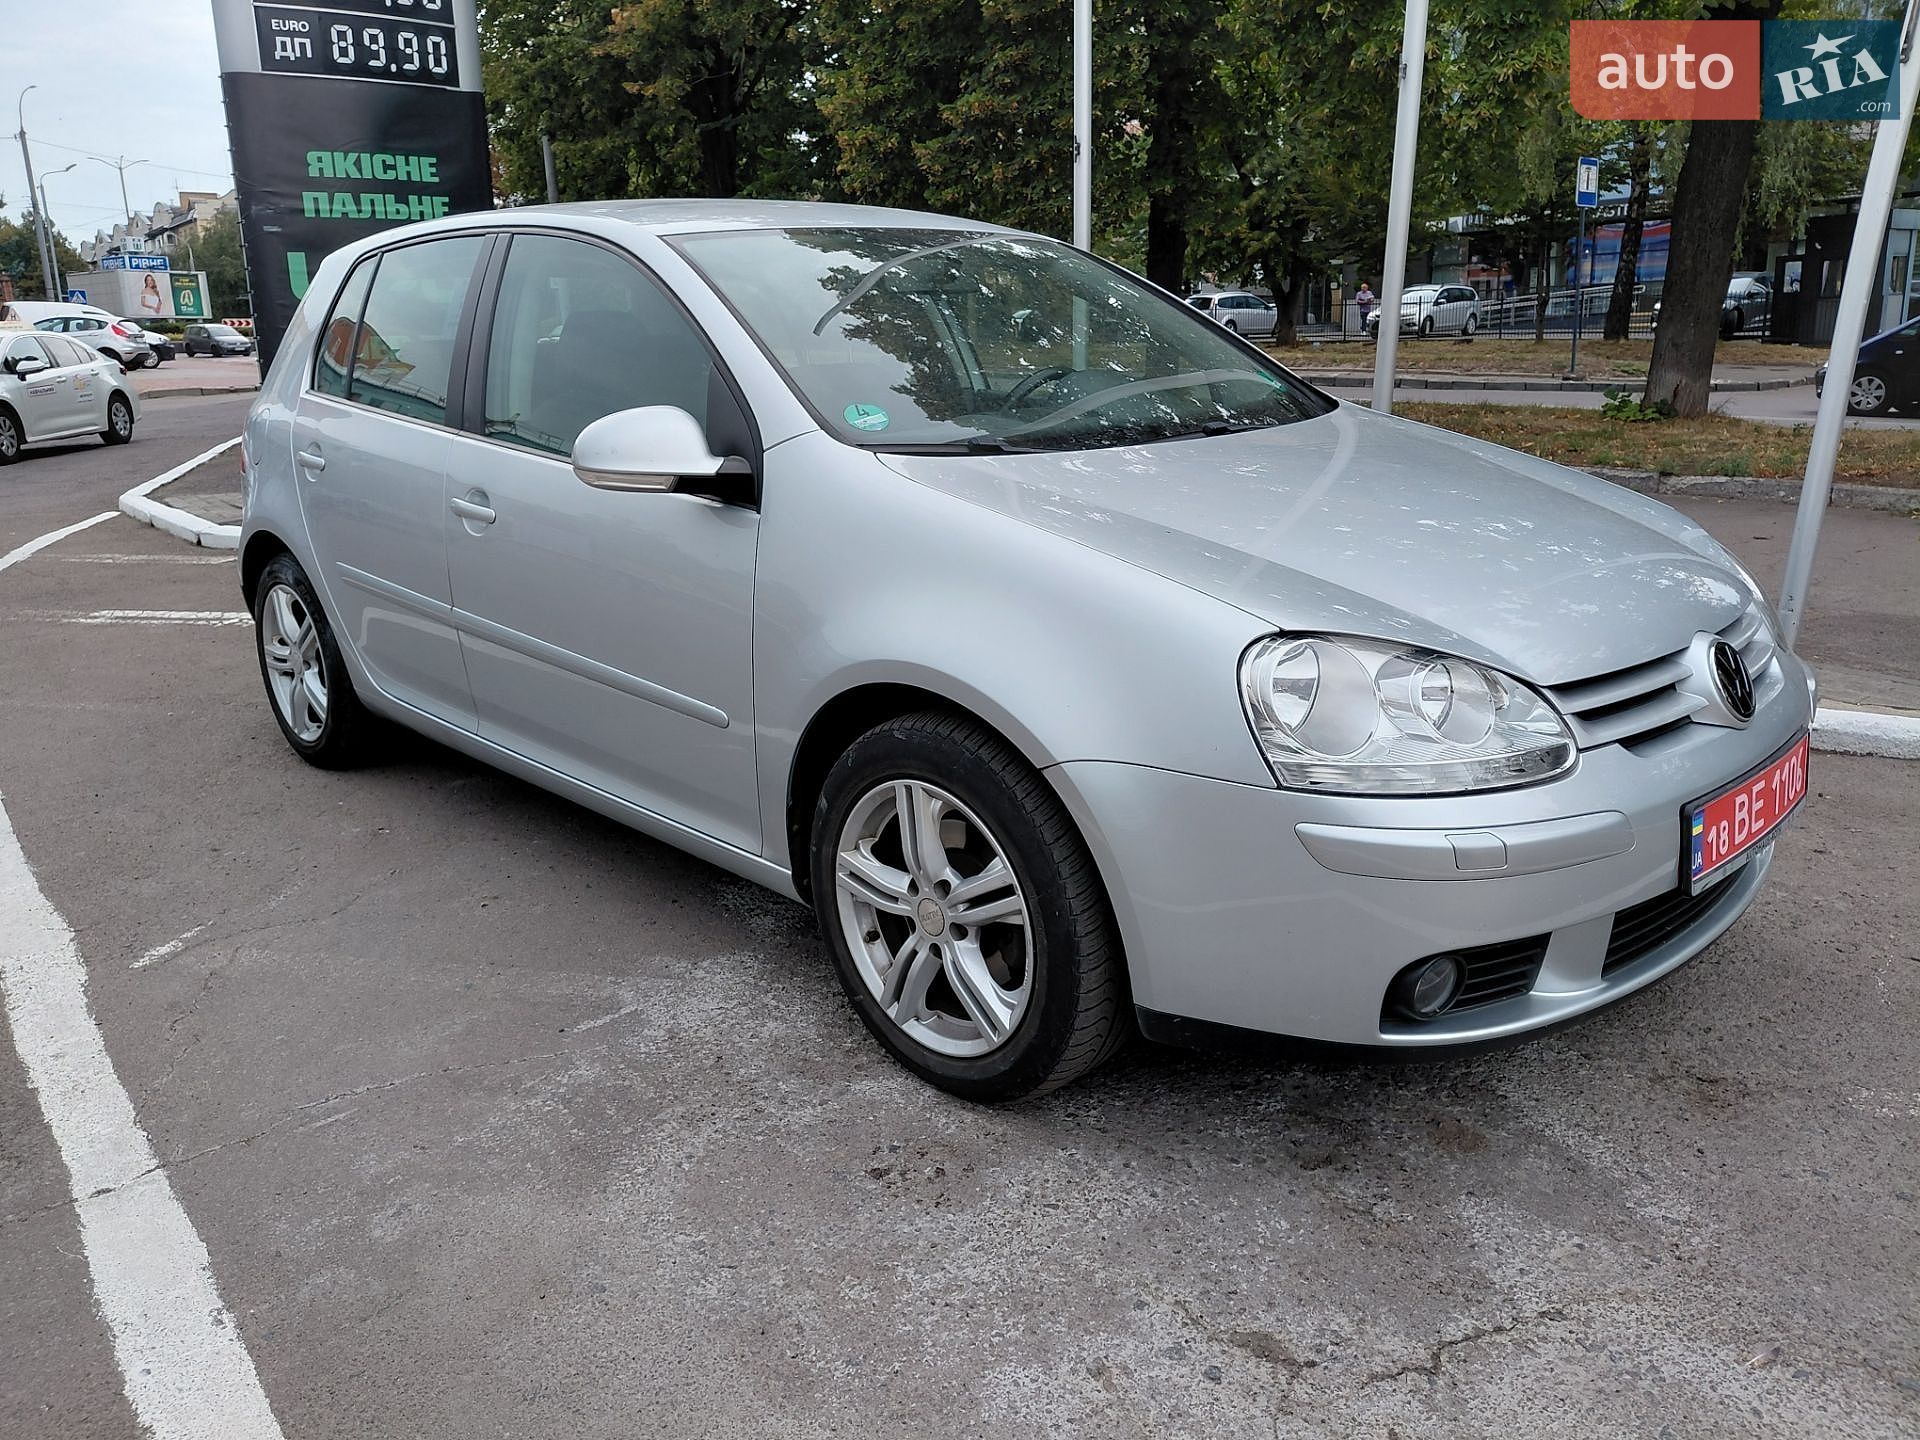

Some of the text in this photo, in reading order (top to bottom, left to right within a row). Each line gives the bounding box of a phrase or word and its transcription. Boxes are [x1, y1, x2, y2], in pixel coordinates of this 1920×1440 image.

[271, 19, 309, 32] EURO
[274, 36, 312, 61] ДП
[330, 24, 448, 74] 89.90
[306, 151, 440, 183] ЯКІСНЕ
[301, 191, 450, 220] ПАЛЬНЕ
[855, 404, 870, 417] 4
[1706, 819, 1730, 862] 18
[1734, 779, 1766, 846] BE
